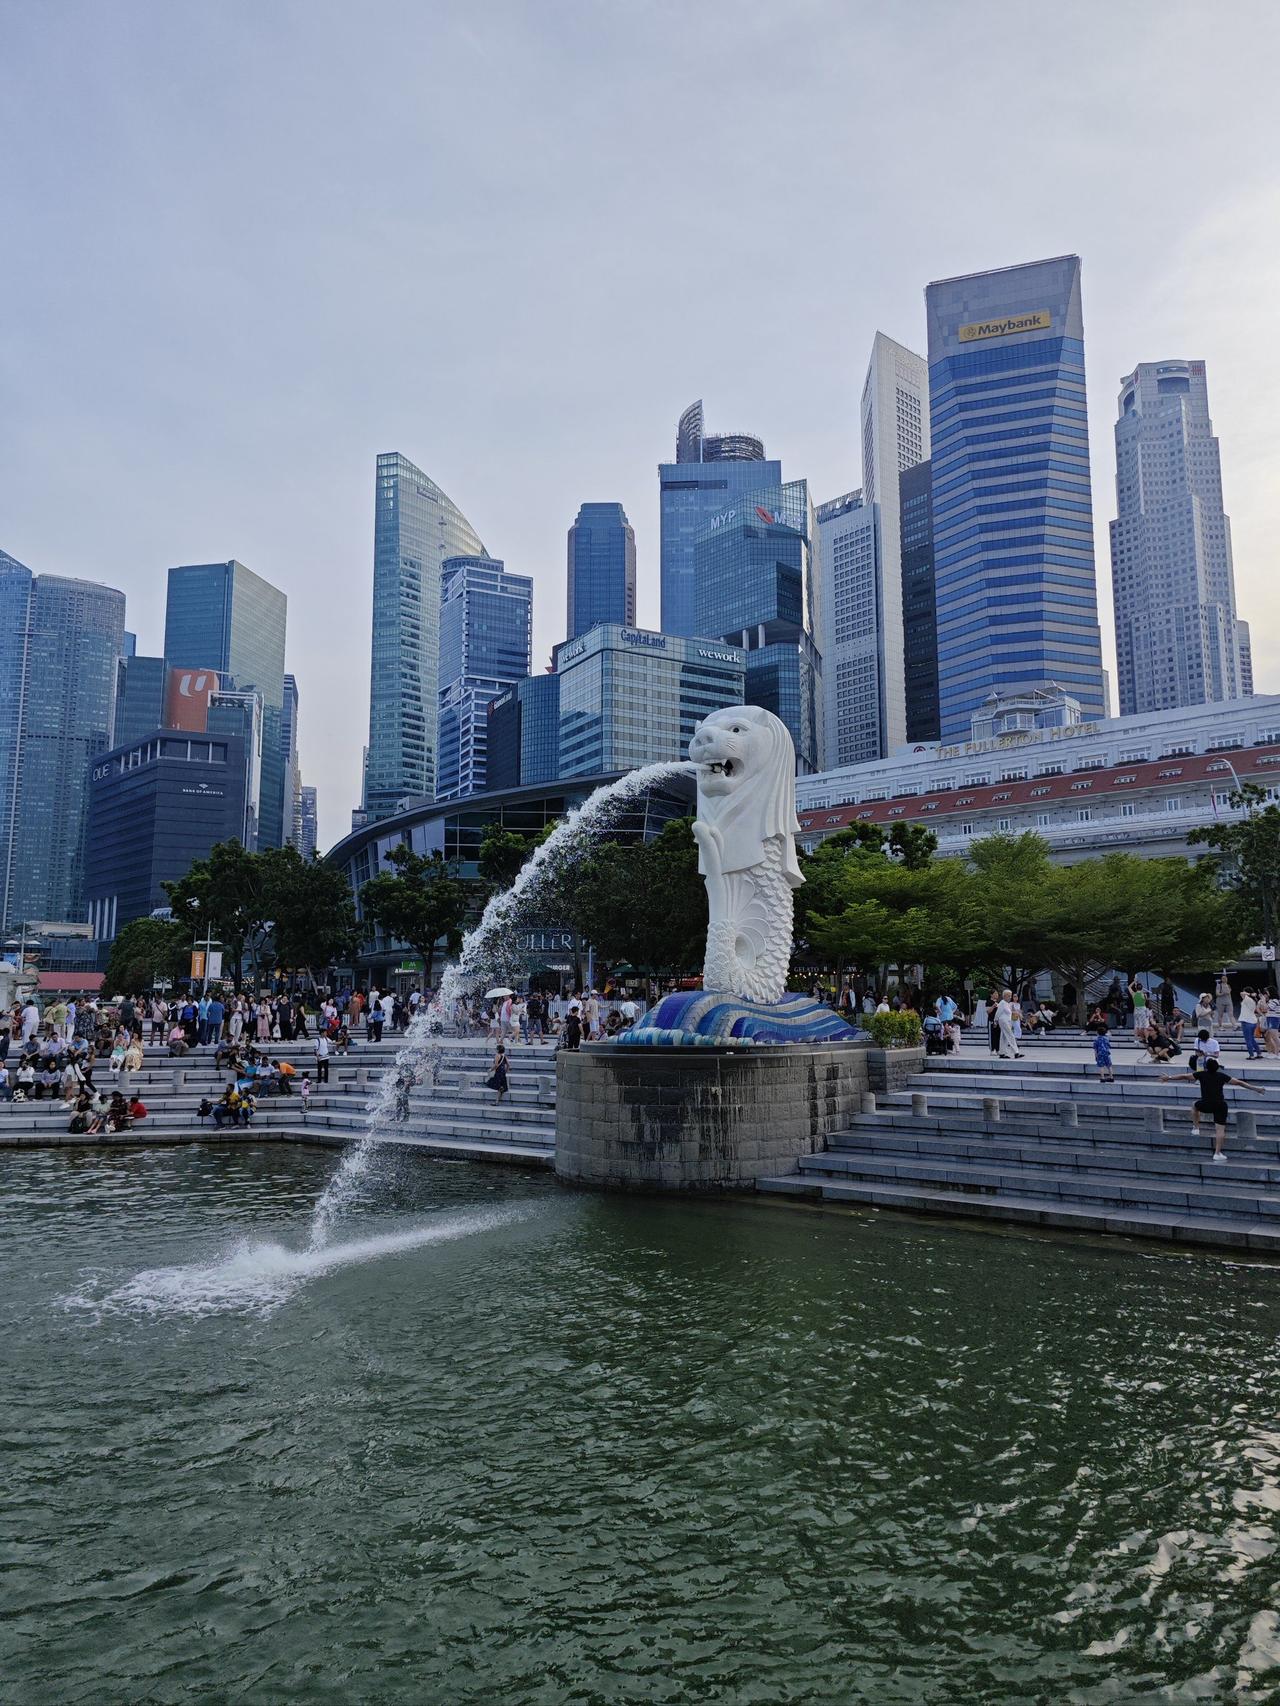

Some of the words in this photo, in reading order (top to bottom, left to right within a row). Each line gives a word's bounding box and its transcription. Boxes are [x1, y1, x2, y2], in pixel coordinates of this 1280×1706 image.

[978, 315, 1042, 336] Maybank
[710, 510, 736, 530] MYP
[621, 629, 666, 648] CapitaLand
[698, 649, 741, 663] wework
[936, 746, 960, 760] THE
[965, 731, 1043, 755] FULLERTON
[1050, 722, 1100, 740] HOTEL
